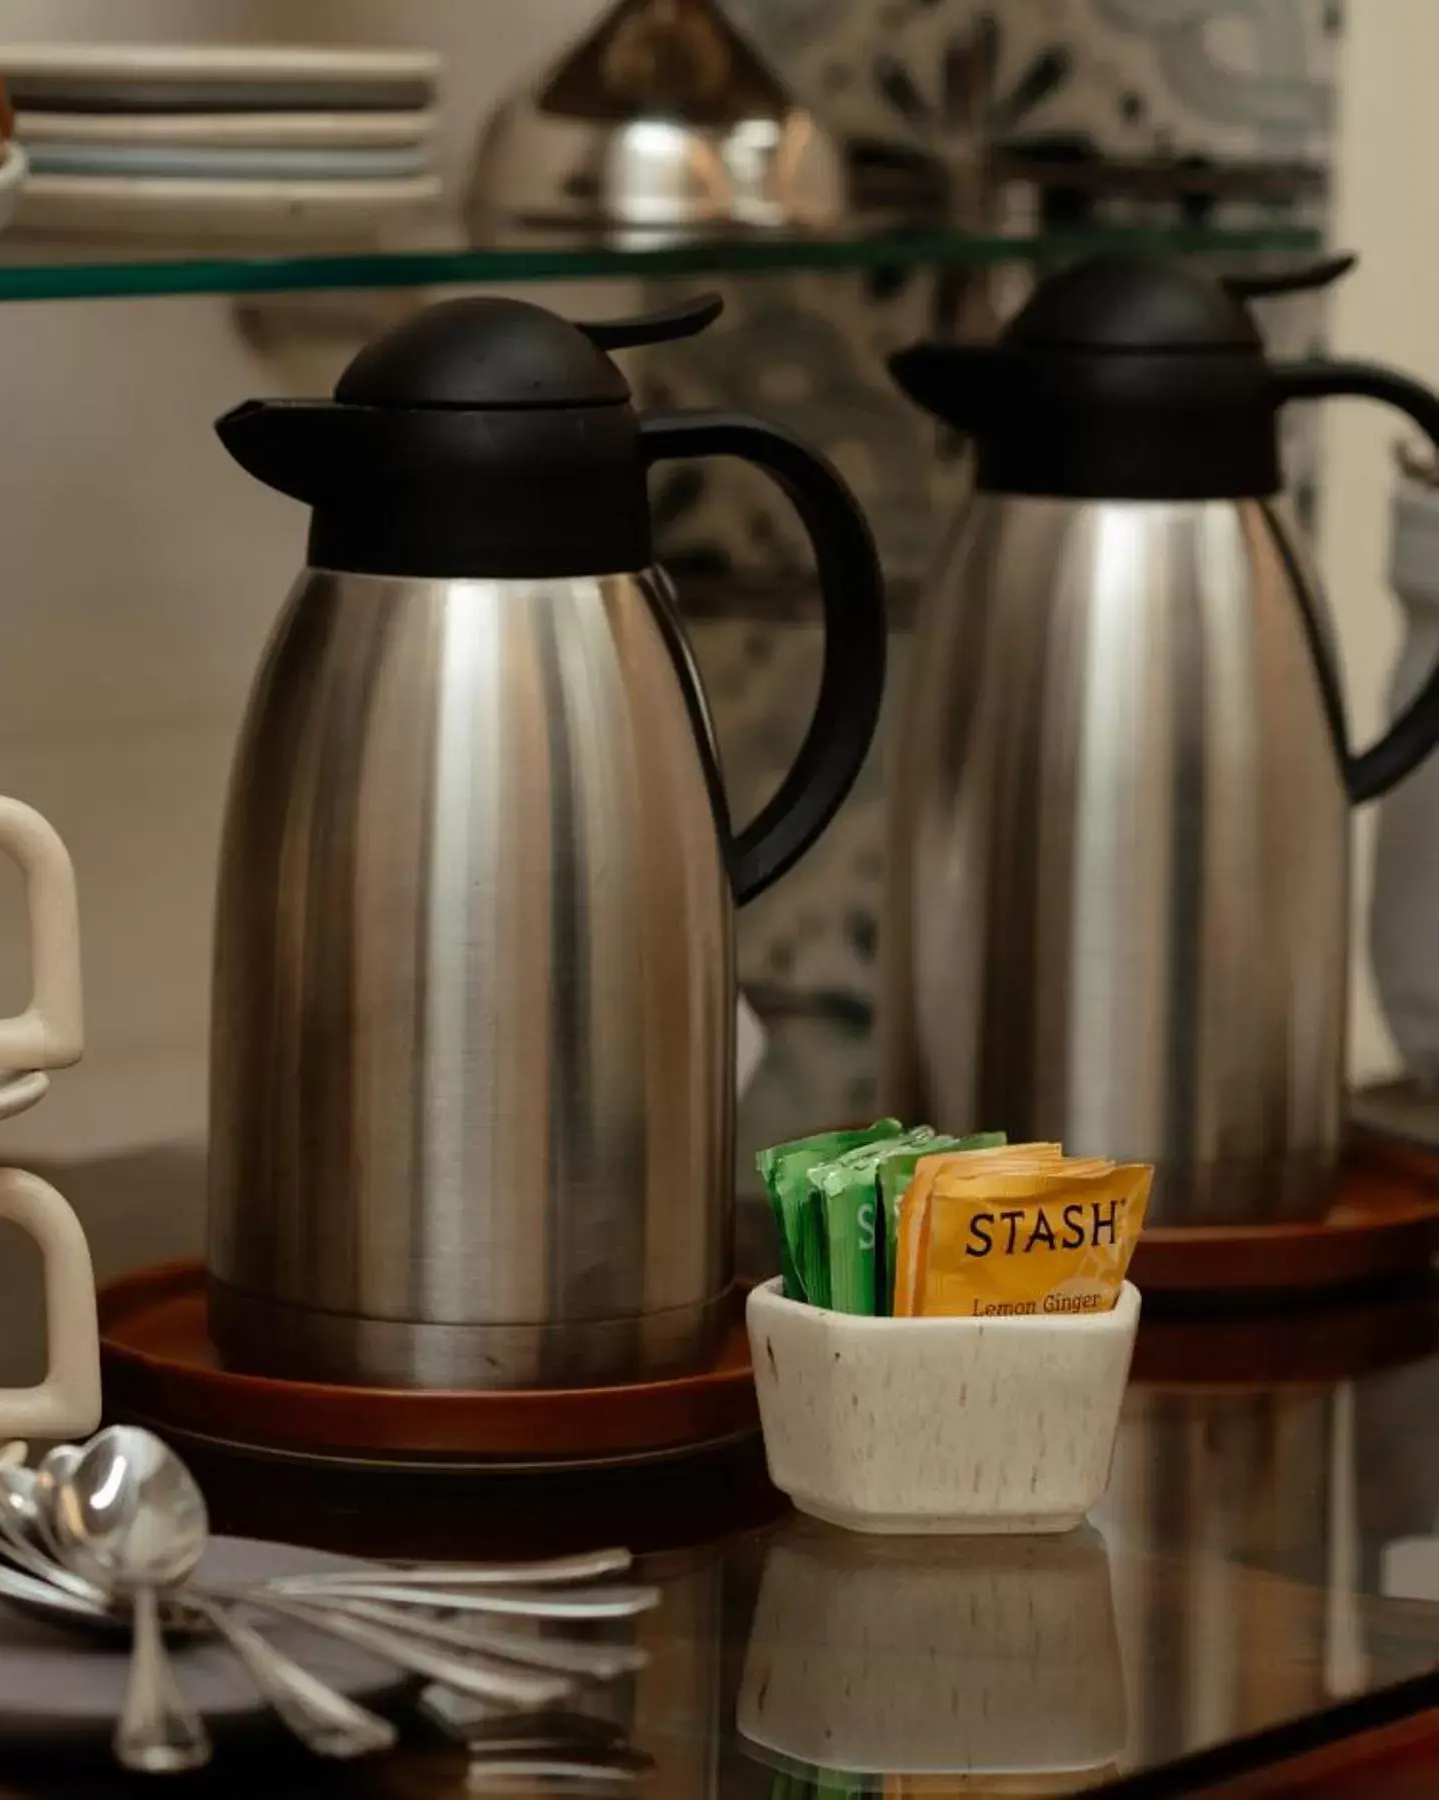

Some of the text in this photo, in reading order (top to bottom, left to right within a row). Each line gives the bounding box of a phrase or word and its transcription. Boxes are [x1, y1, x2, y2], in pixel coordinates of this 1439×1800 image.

[964, 1200, 1117, 1257] STASH
[972, 1292, 1102, 1317] Lemon Ginger
